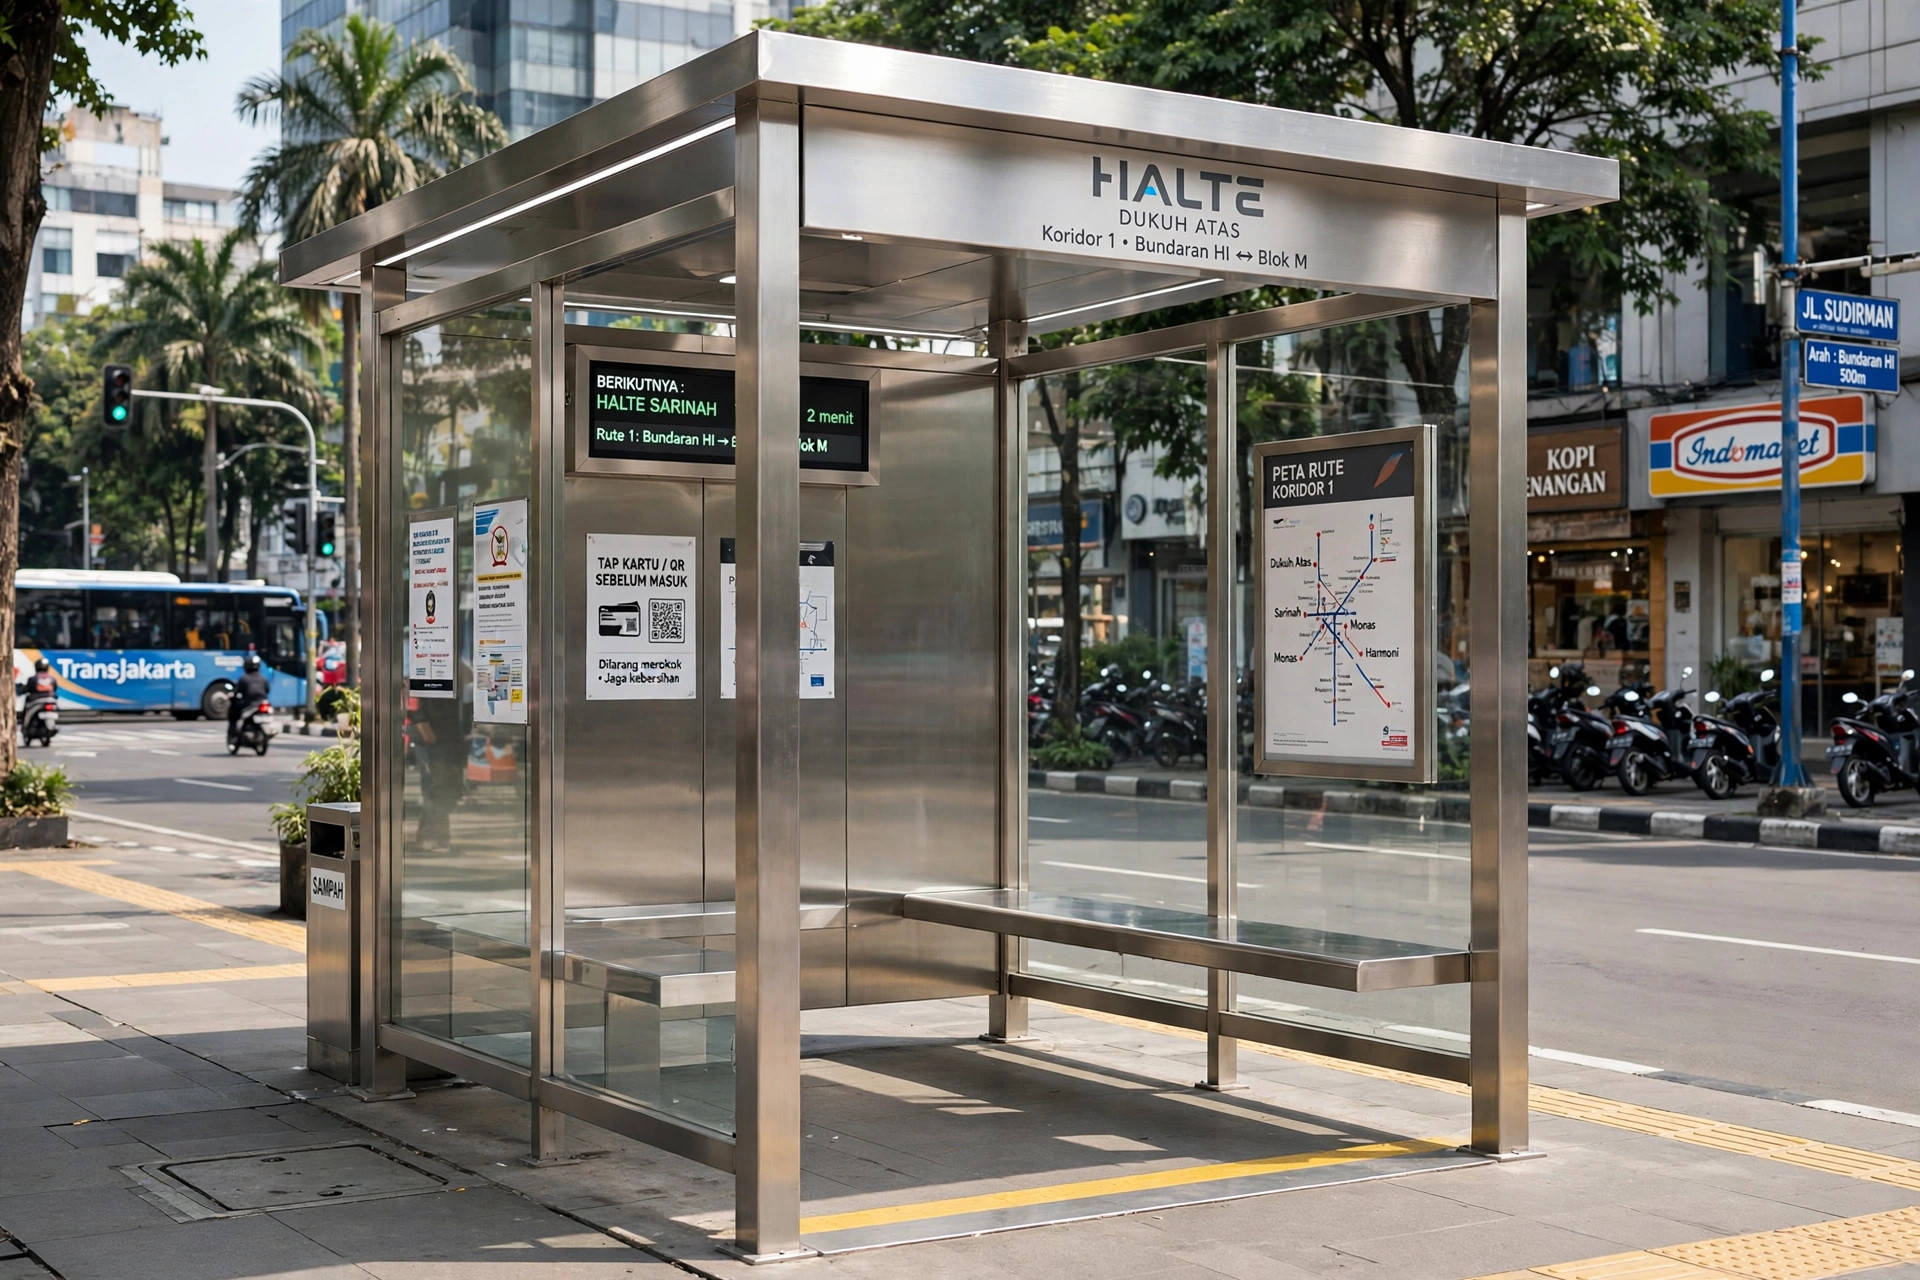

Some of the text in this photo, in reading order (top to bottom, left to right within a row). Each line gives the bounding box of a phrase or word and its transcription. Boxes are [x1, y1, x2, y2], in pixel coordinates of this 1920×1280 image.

[1092, 156, 1264, 217] HALTE
[1120, 209, 1240, 239] DUKUH ATAS
[1042, 225, 1308, 270] Koridor 1 Bundaran HI Blok M
[1802, 296, 1822, 320] JL.
[1824, 298, 1894, 329] SUDIRMAN
[1808, 346, 1831, 362] Arah
[1838, 349, 1882, 368] Bundaran
[1884, 353, 1895, 370] HI
[1839, 368, 1867, 385] 500m
[596, 394, 718, 417] HALTE SARINAH
[806, 408, 854, 425] 2 menit
[596, 427, 625, 442] Rute
[642, 430, 699, 446] Bundaran
[702, 434, 715, 446] HI
[817, 440, 829, 454] M
[1547, 445, 1595, 471] KOPI
[1272, 459, 1344, 482] PETA RUTE
[1272, 480, 1334, 499] KORIDOR 1
[598, 557, 619, 569] TAP
[623, 558, 659, 570] KARTU
[670, 559, 685, 571] QR
[1270, 556, 1312, 568] Dukuh Atas
[595, 573, 688, 587] SEBELUM MASUK
[1274, 606, 1301, 618] Sarinah
[599, 658, 682, 672] Dilarang merokok
[604, 672, 680, 686] Jaga kebersihan
[312, 876, 344, 900] SAMPAH
